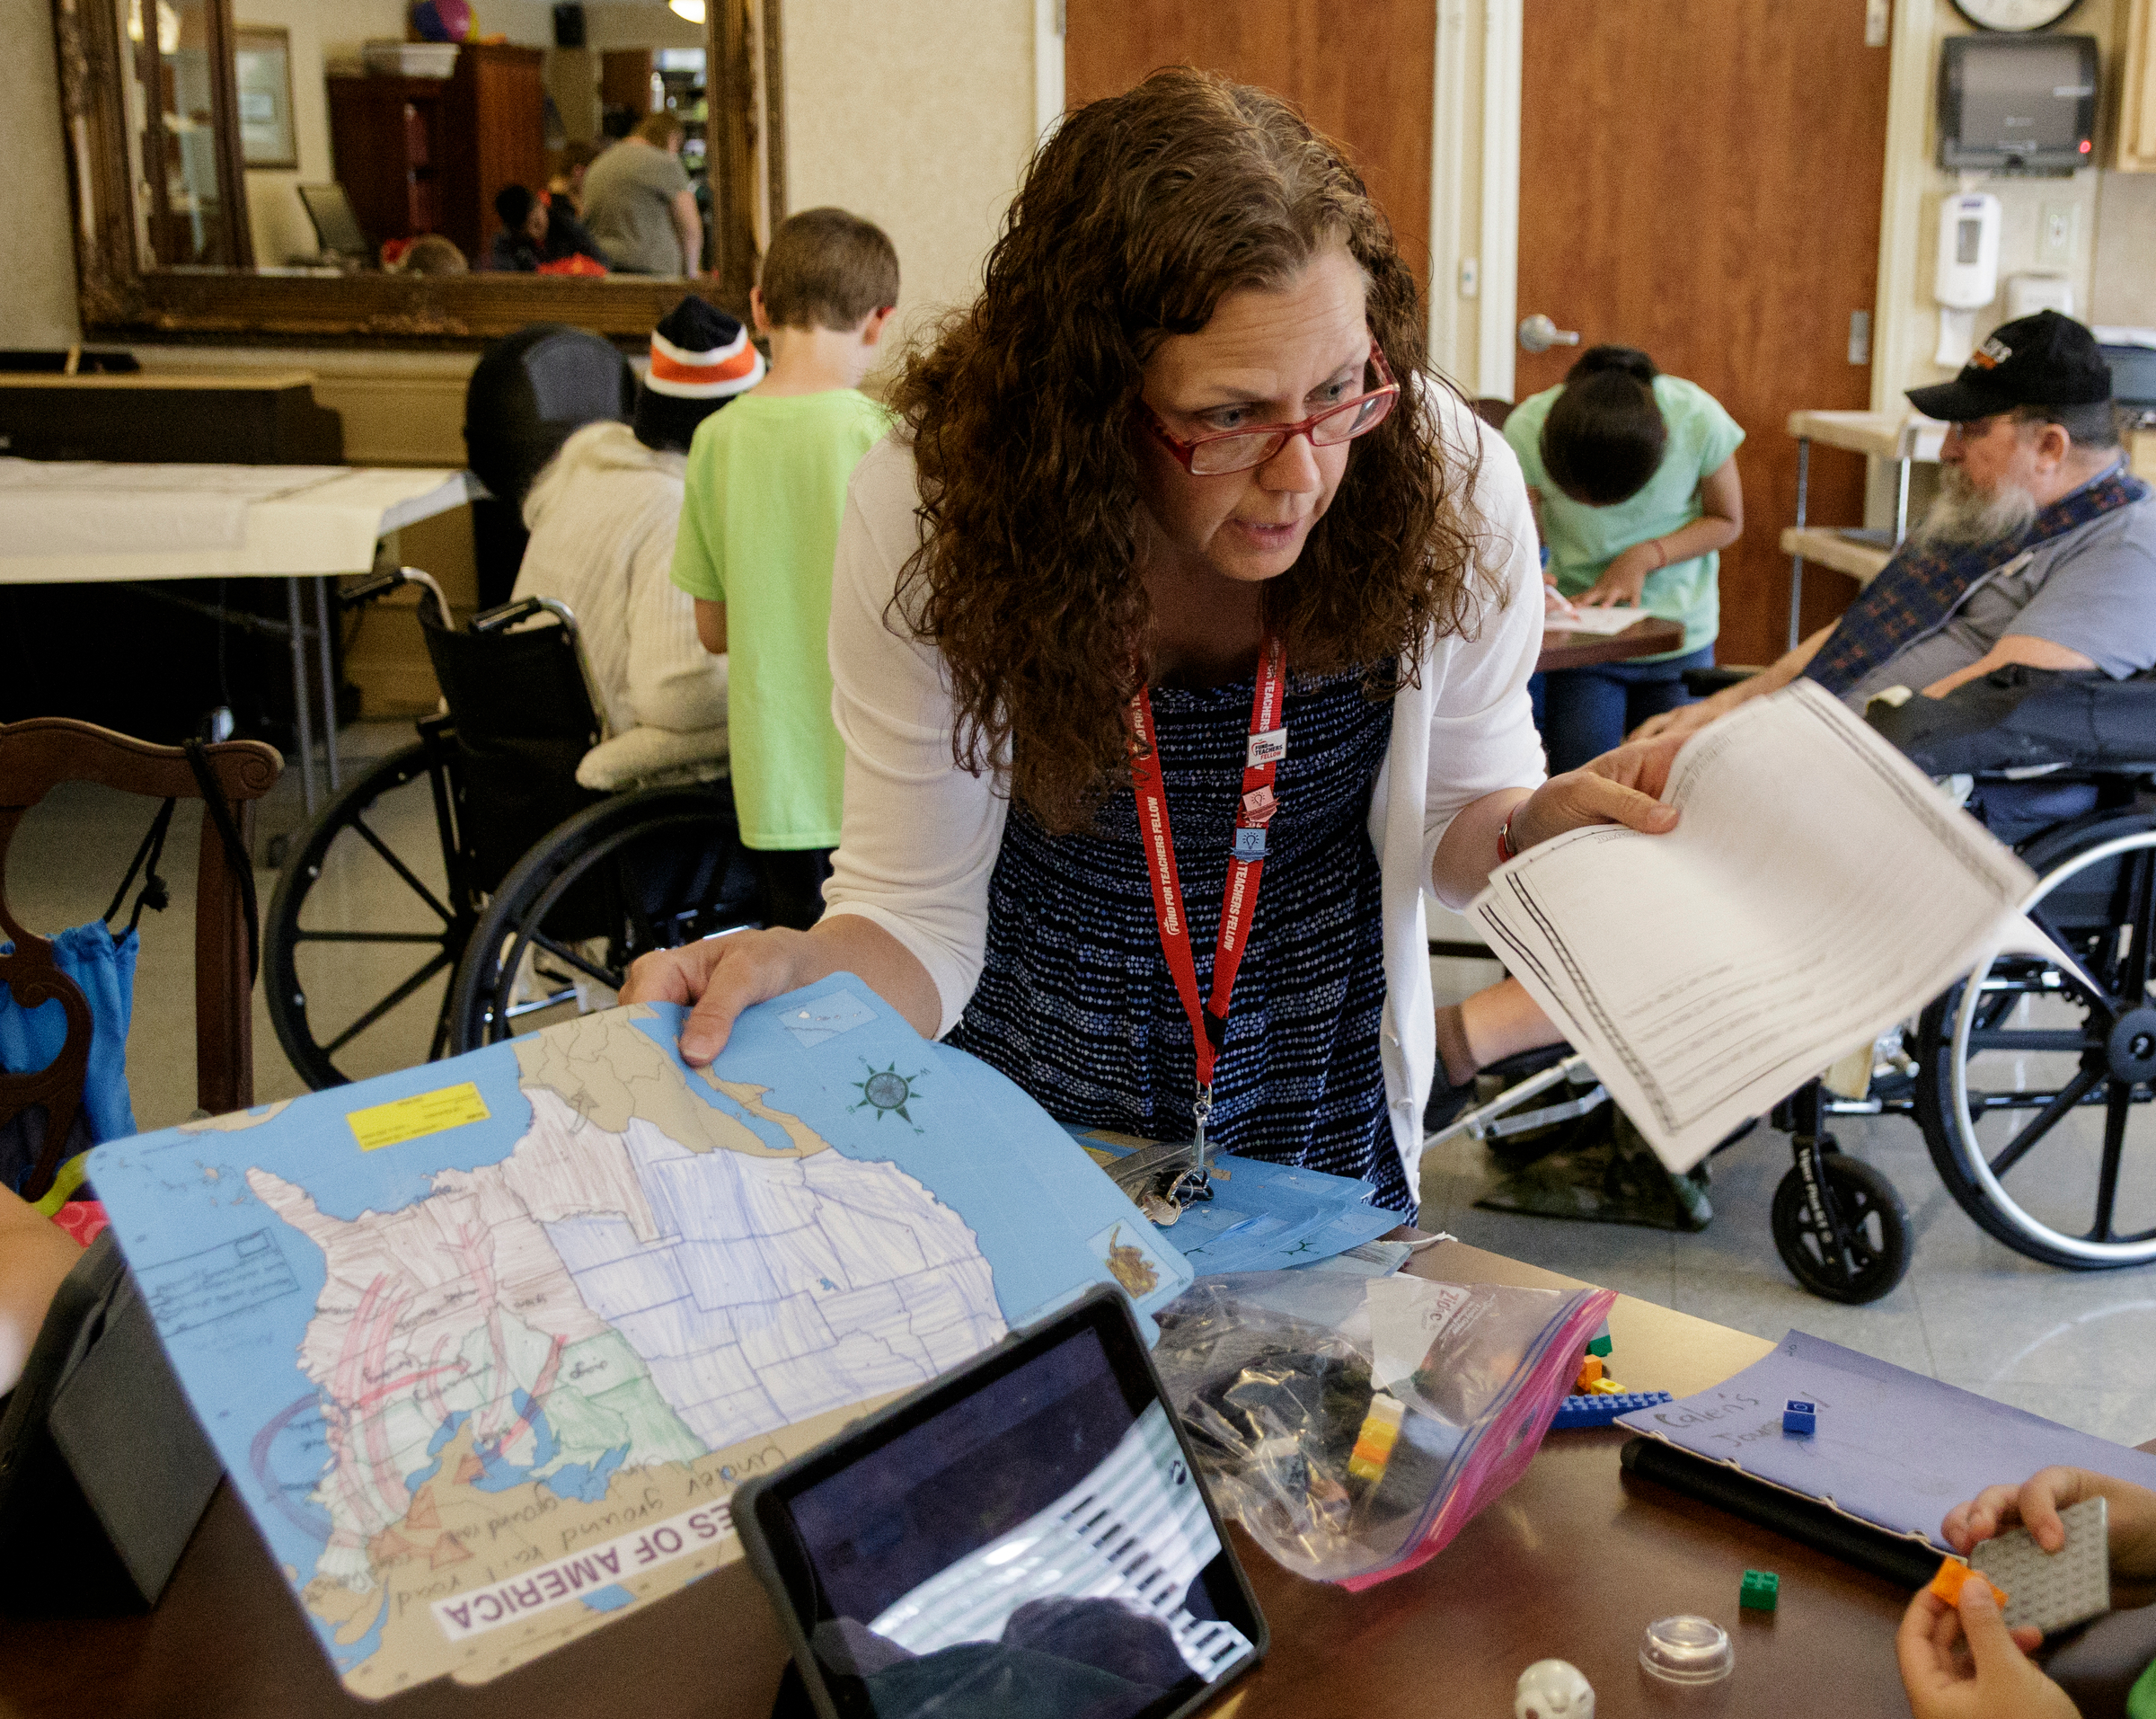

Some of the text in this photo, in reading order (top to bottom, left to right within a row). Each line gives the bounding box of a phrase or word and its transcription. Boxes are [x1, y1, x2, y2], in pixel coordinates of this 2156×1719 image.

[1259, 679, 1277, 732] TEACHERS
[1255, 745, 1283, 756] TEACHERS
[1260, 751, 1281, 759] FELLOW
[1147, 796, 1180, 935] FUND FOR TEACHERS FELLOW
[1223, 864, 1249, 953] TEACHERS FELLOW
[687, 1445, 788, 1497] Under
[561, 1486, 664, 1551] ground
[633, 1527, 684, 1565] OF
[397, 1574, 462, 1617] road
[442, 1546, 621, 1630] AMERICA
